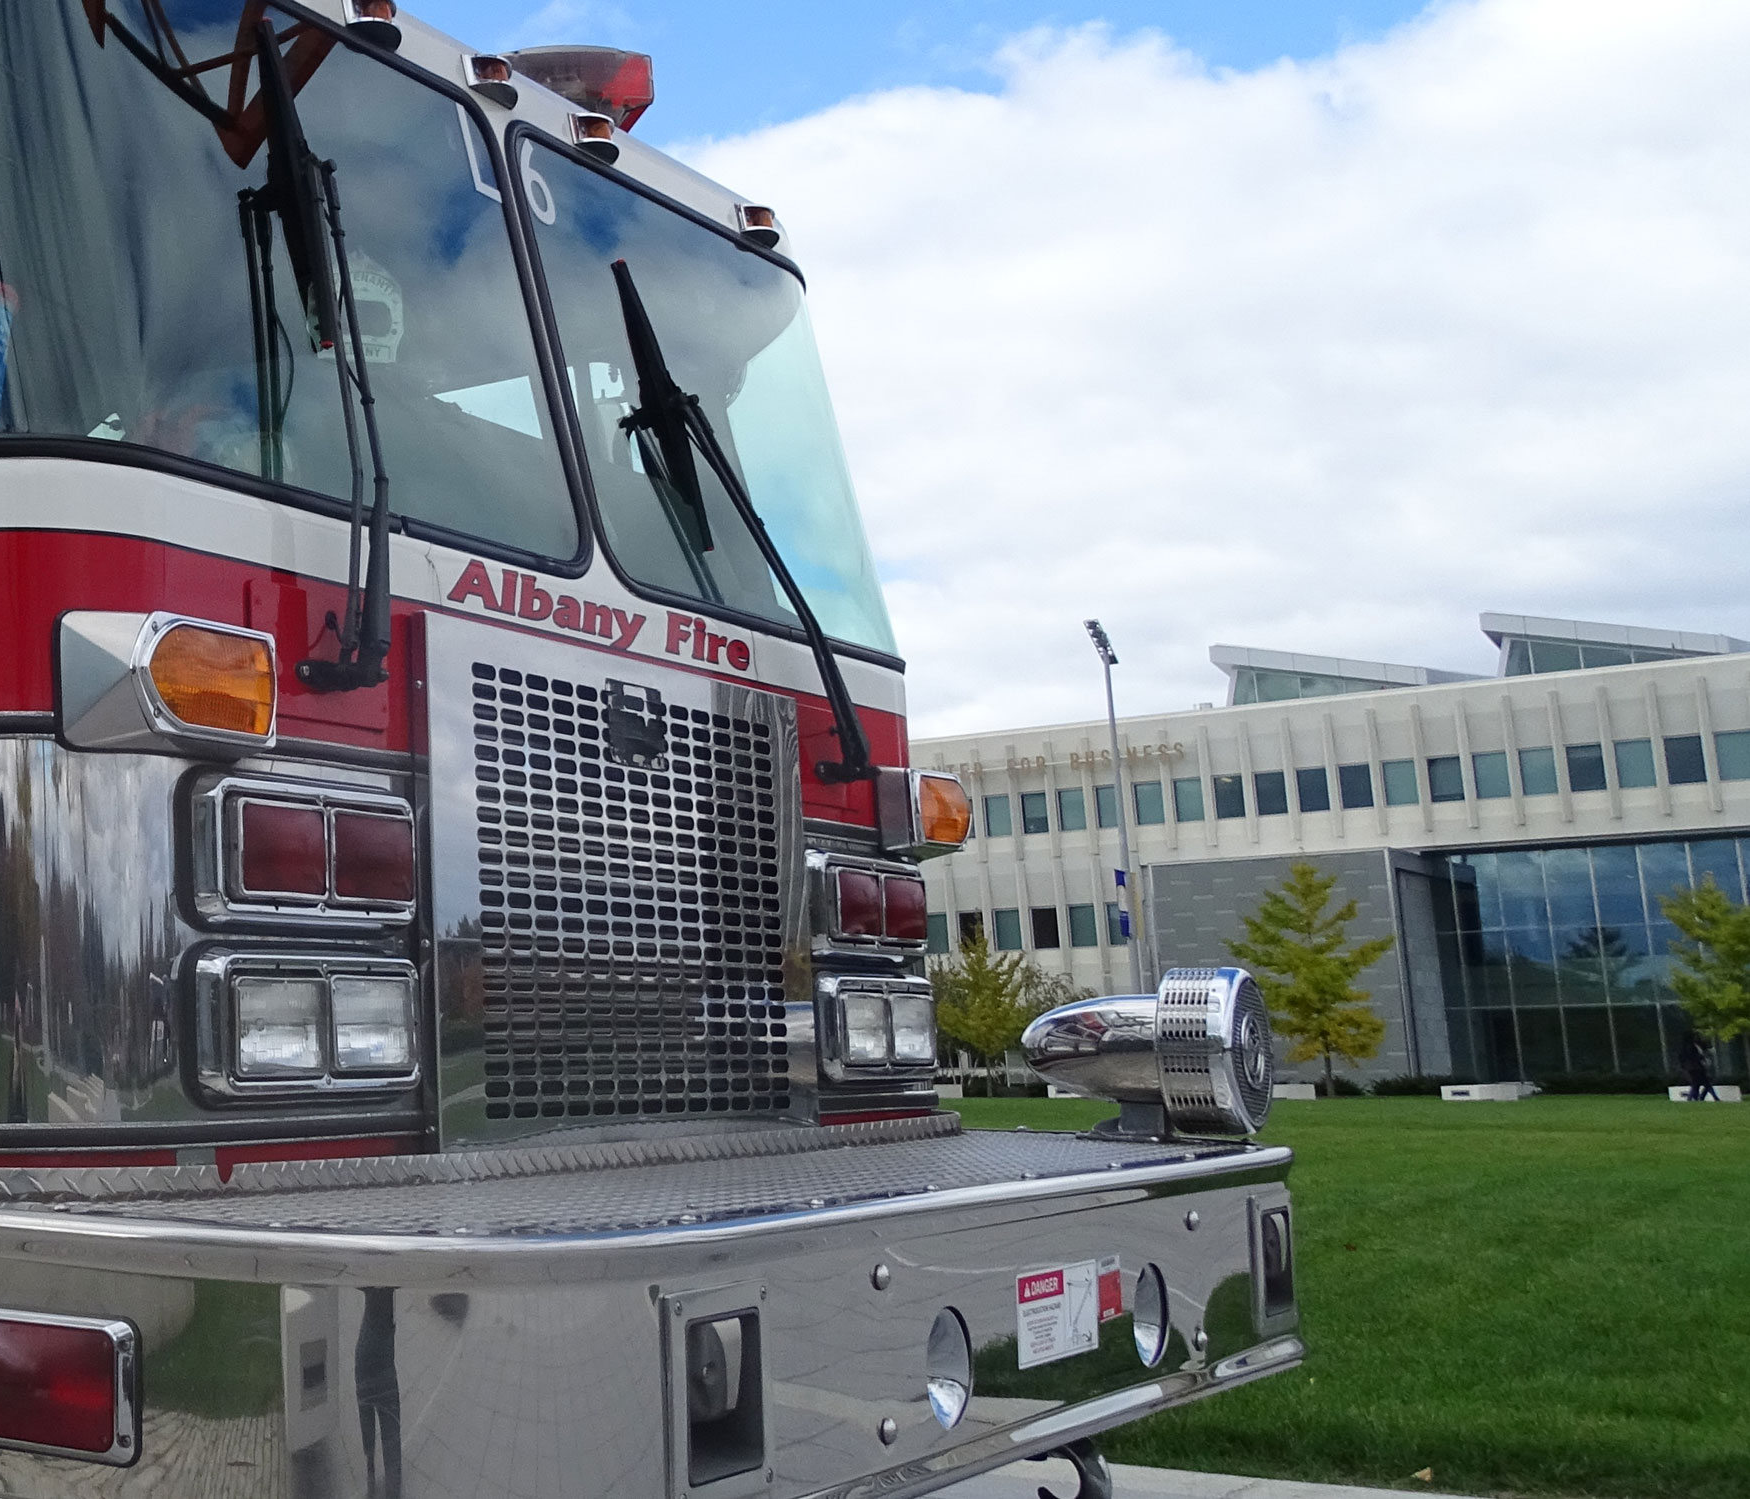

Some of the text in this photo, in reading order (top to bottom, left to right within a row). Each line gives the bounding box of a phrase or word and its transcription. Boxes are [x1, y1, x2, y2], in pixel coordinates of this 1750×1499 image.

[520, 138, 556, 225] 6
[447, 559, 750, 671] Albany Fire
[1006, 754, 1046, 775] FOR
[1070, 742, 1186, 771] BUSNESS
[1031, 1277, 1059, 1296] DANGER
